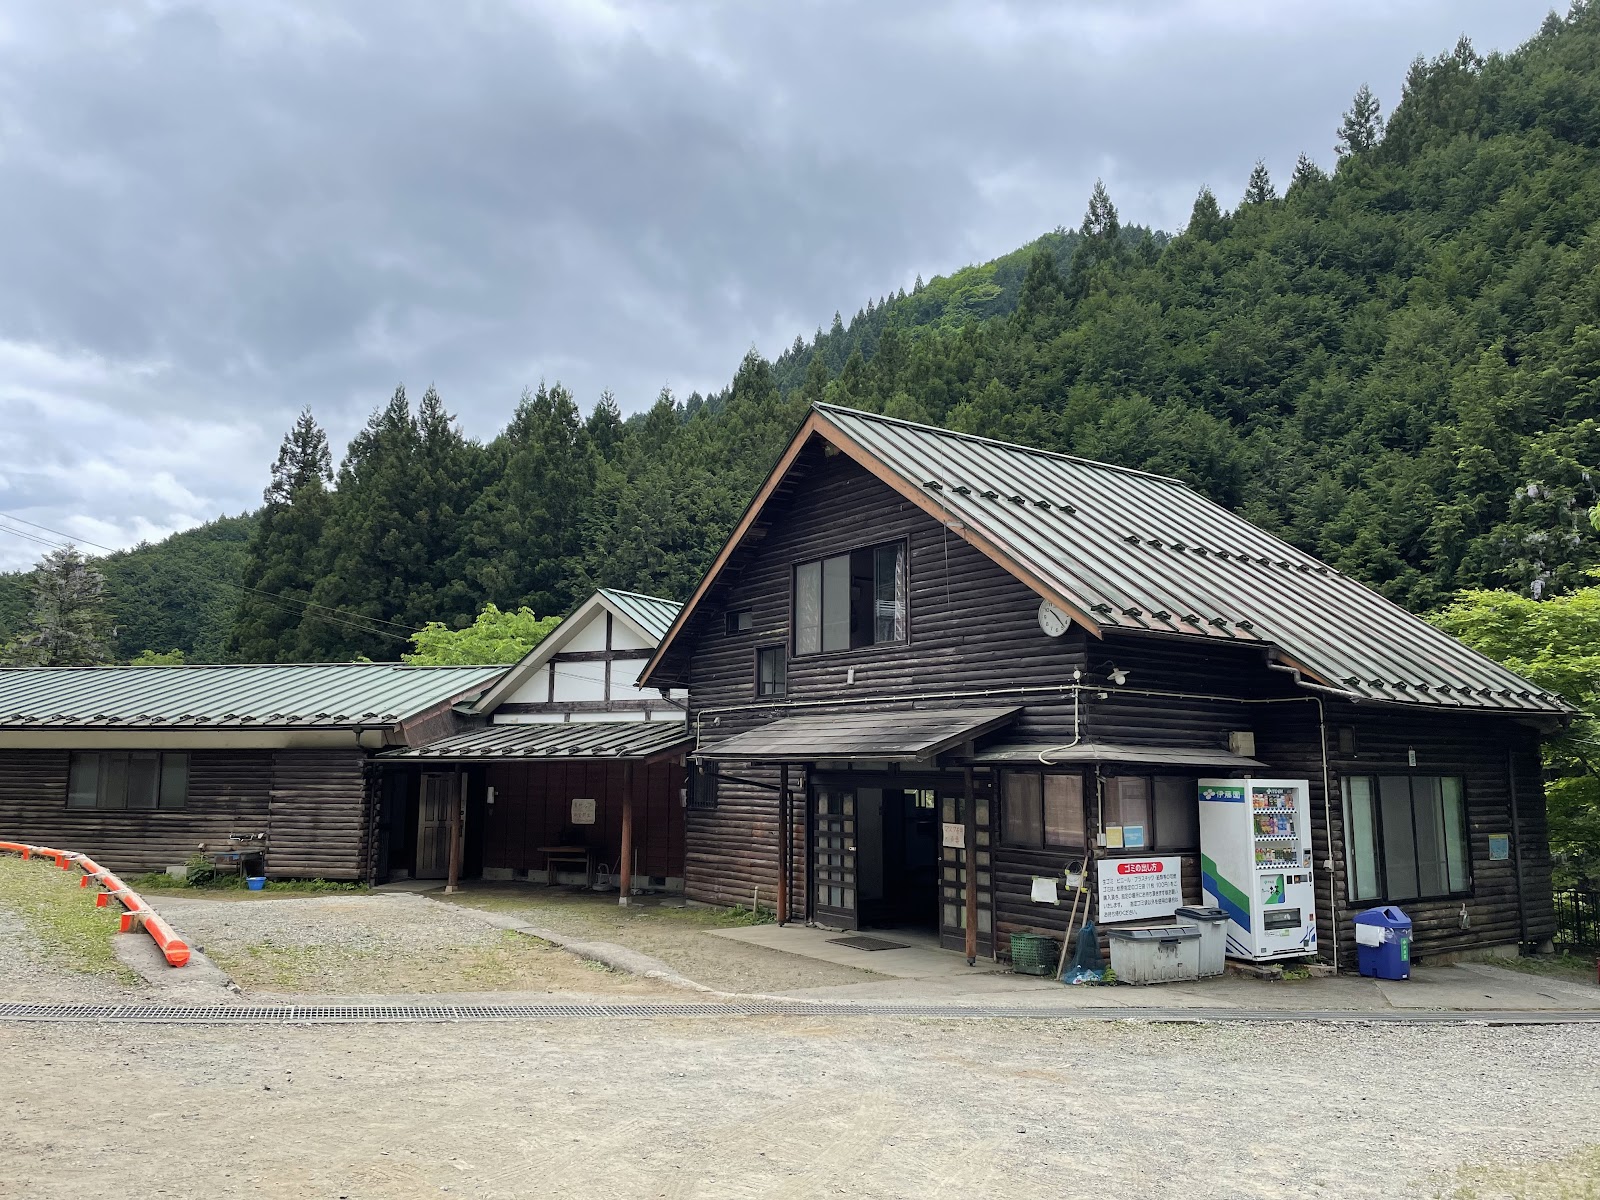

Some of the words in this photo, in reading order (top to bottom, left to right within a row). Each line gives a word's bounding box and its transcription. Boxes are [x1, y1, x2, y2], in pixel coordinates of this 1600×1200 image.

[1216, 790, 1240, 799] 伊藤園
[1124, 864, 1157, 873] ゴミの出し方
